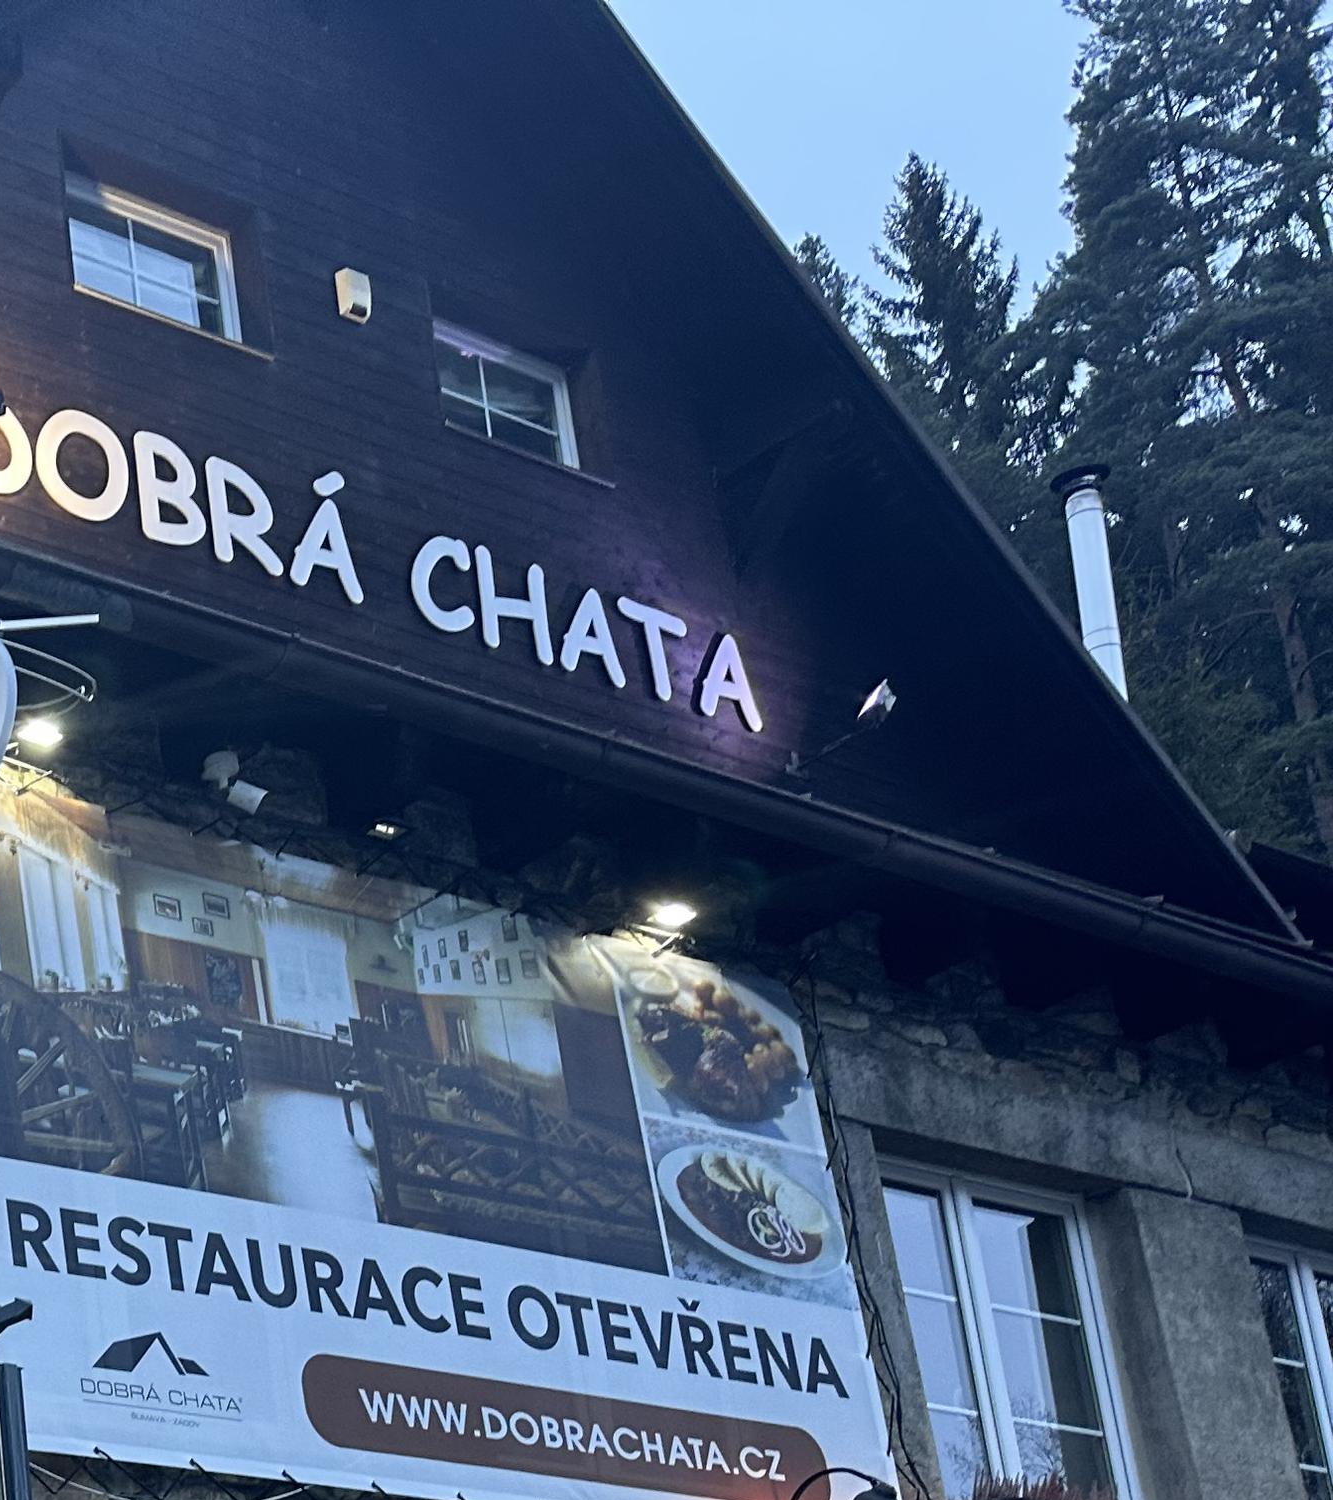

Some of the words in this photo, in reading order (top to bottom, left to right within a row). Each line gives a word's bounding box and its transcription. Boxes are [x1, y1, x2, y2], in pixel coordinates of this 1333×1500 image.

[410, 535, 764, 733] CHATA
[6, 1198, 492, 1341] RESTAURACE
[507, 1284, 850, 1400] OTEVŘENA
[80, 1377, 162, 1403] DOBRÁ
[357, 1387, 788, 1483] WWW.DOBRACHATA.CZ
